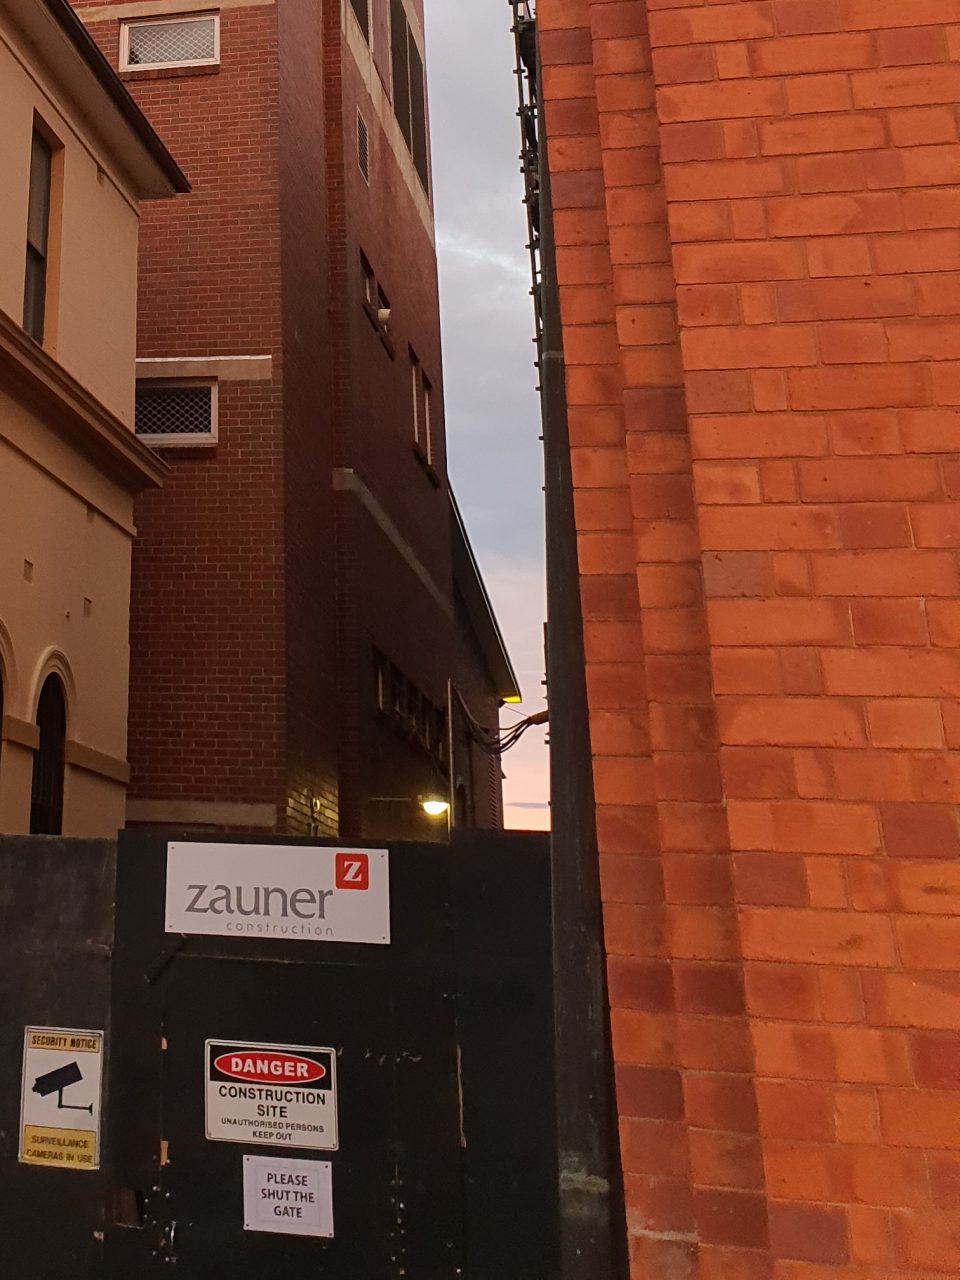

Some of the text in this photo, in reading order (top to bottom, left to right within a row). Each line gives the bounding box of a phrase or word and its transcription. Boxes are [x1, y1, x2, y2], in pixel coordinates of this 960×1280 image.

[185, 884, 334, 920] zauner
[226, 921, 335, 937] construction
[31, 1035, 97, 1049] SECURITY NOTICE
[231, 1057, 309, 1078] DANGER
[218, 1085, 326, 1105] CONSTRUCTION
[257, 1104, 288, 1118] SITE
[221, 1117, 325, 1133] UNAUTHORISED PERSONS
[31, 1135, 89, 1149] SURVEILLANCE
[252, 1130, 293, 1141] KEEP OUT
[26, 1149, 93, 1164] CAMERAS IN USE
[267, 1172, 308, 1187] PLEASE
[261, 1188, 316, 1204] SHUT THE
[273, 1205, 303, 1219] GATE
